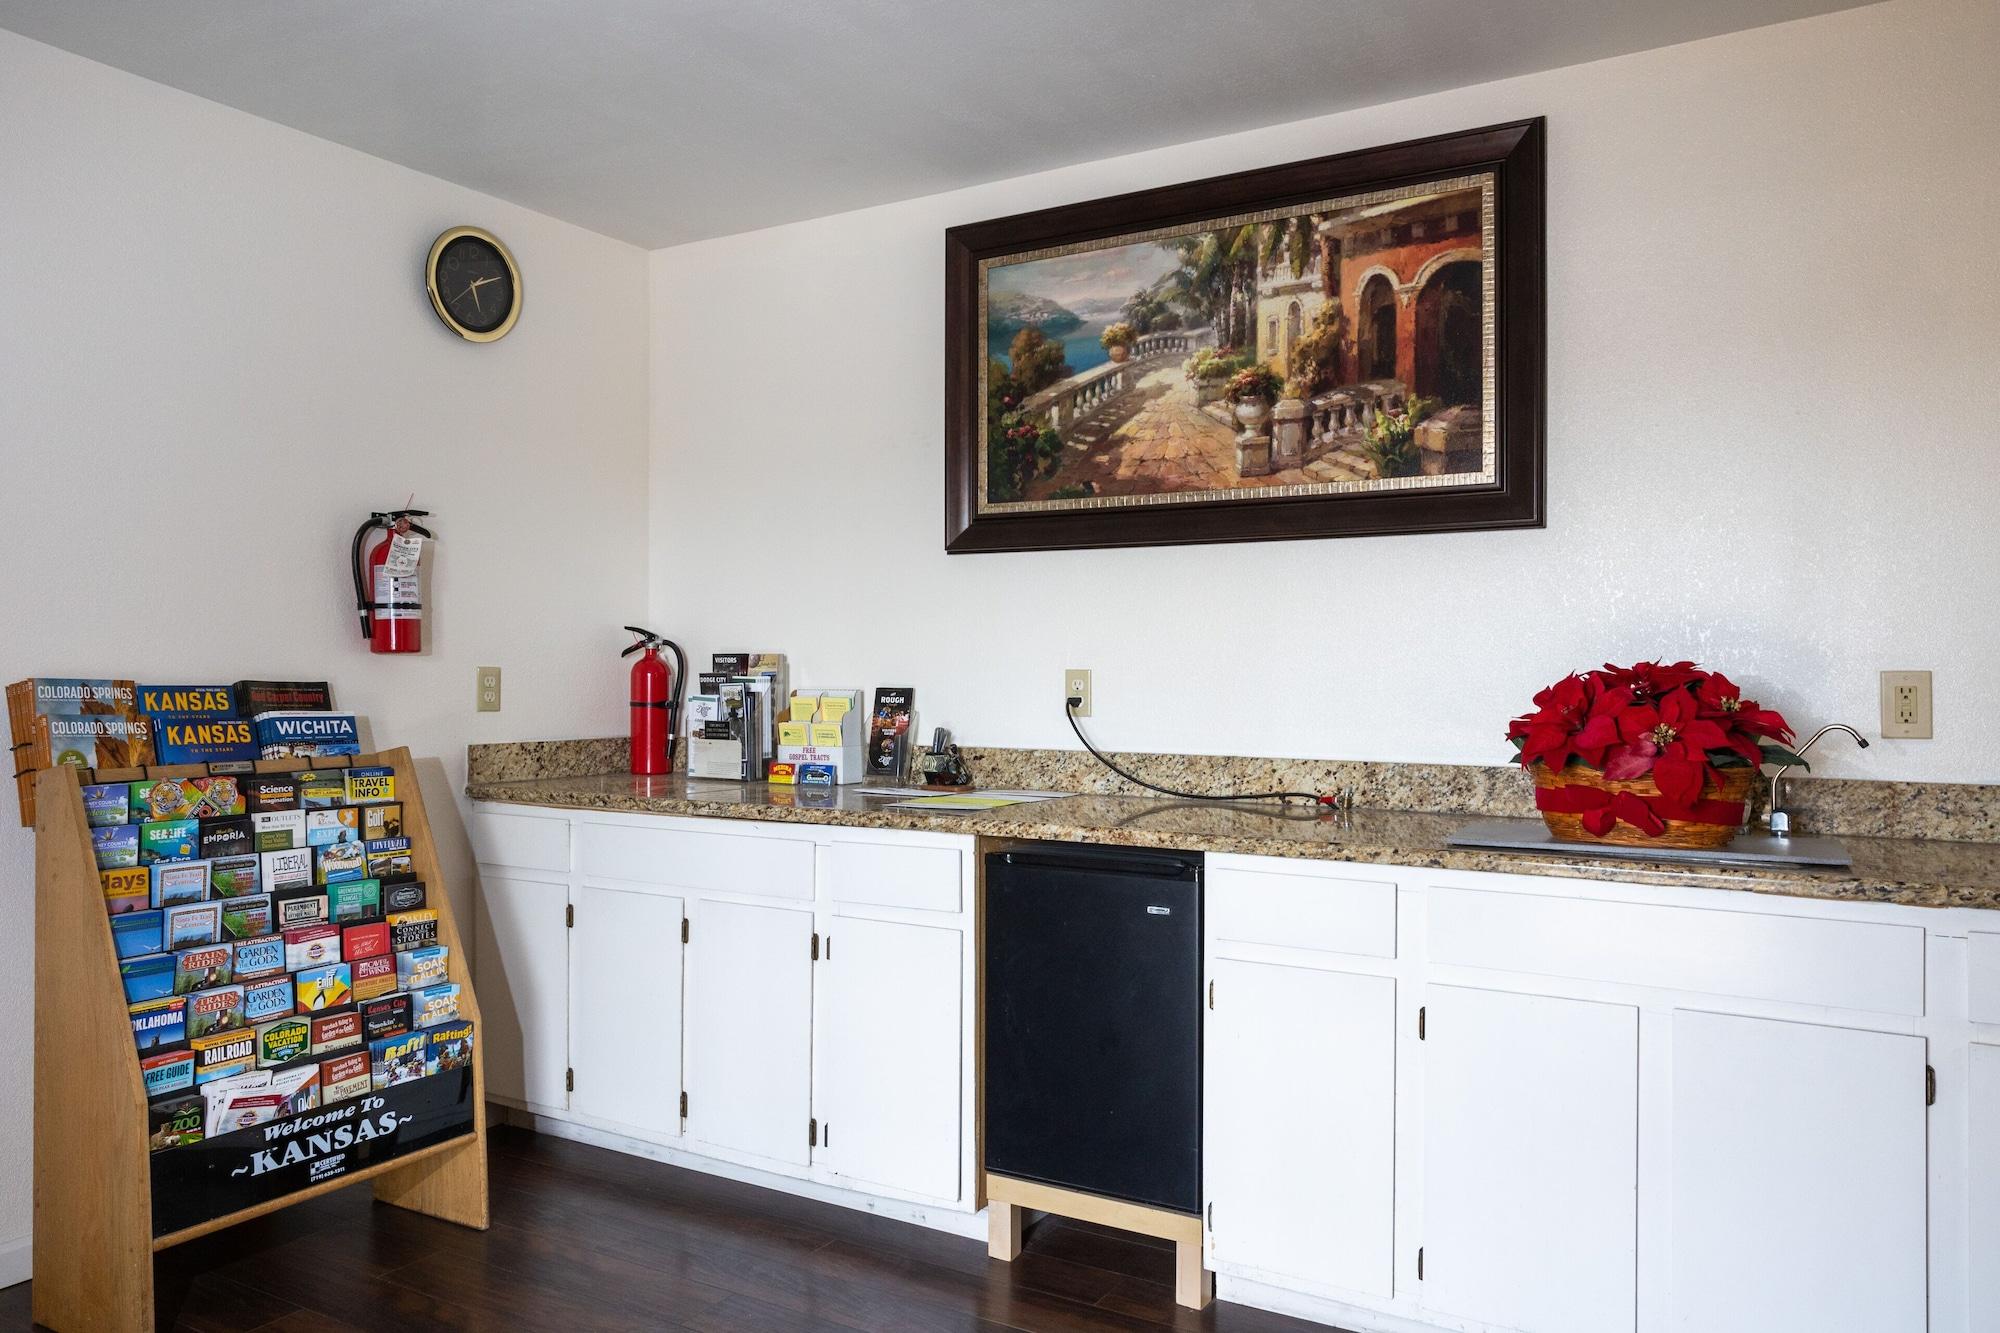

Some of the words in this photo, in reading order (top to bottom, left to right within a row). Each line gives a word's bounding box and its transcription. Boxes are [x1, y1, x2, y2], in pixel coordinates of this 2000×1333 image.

[38, 686, 90, 699] COLORADO
[92, 687, 133, 700] SPRINGS
[144, 692, 229, 711] KANSAS
[52, 722, 104, 734] COLORADO
[105, 722, 148, 734] SPRINGS
[276, 720, 353, 735] WICHITA
[167, 725, 252, 746] KANSAS
[260, 785, 294, 794] Science
[354, 778, 390, 788] TRAVEL
[355, 787, 380, 798] INFO
[367, 808, 385, 828] Golf
[150, 829, 167, 840] SEA
[169, 828, 187, 838] LIFE
[273, 854, 308, 872] LIBERAL
[288, 903, 316, 912] PARAMOUNT
[397, 922, 435, 934] CONNECT
[247, 936, 281, 945] ATTRACTION
[397, 930, 435, 944] STORIES
[188, 950, 224, 961] TRAIN
[238, 945, 279, 960] GARDEN
[188, 958, 224, 968] RIDES
[249, 954, 279, 967] GODS
[368, 959, 383, 967] CAVE
[417, 957, 446, 972] SOAK
[369, 965, 391, 976] WINDS
[411, 975, 419, 984] IT
[420, 971, 437, 980] ALL
[254, 978, 288, 990] ATTRACTION
[200, 992, 236, 1005] TRAIN
[246, 988, 286, 1003] GARDEN
[427, 994, 457, 1011] SOAK
[200, 1000, 236, 1012] RIDES
[258, 996, 287, 1010] GODS
[367, 1004, 391, 1015] Kansas
[393, 999, 407, 1009] City
[131, 1011, 183, 1031] OKLAHOMA
[421, 1013, 430, 1022] IT
[431, 1008, 447, 1017] ALL
[264, 1025, 307, 1043] COLORADO
[432, 1024, 473, 1044] Rafting!
[268, 1035, 303, 1049] VACATION
[384, 1034, 425, 1062] Raft!
[204, 1040, 253, 1066] RAILROAD
[146, 1068, 165, 1085] FREE
[166, 1062, 190, 1079] GUIDE
[264, 1105, 355, 1142] Welcome
[361, 1096, 385, 1113] To
